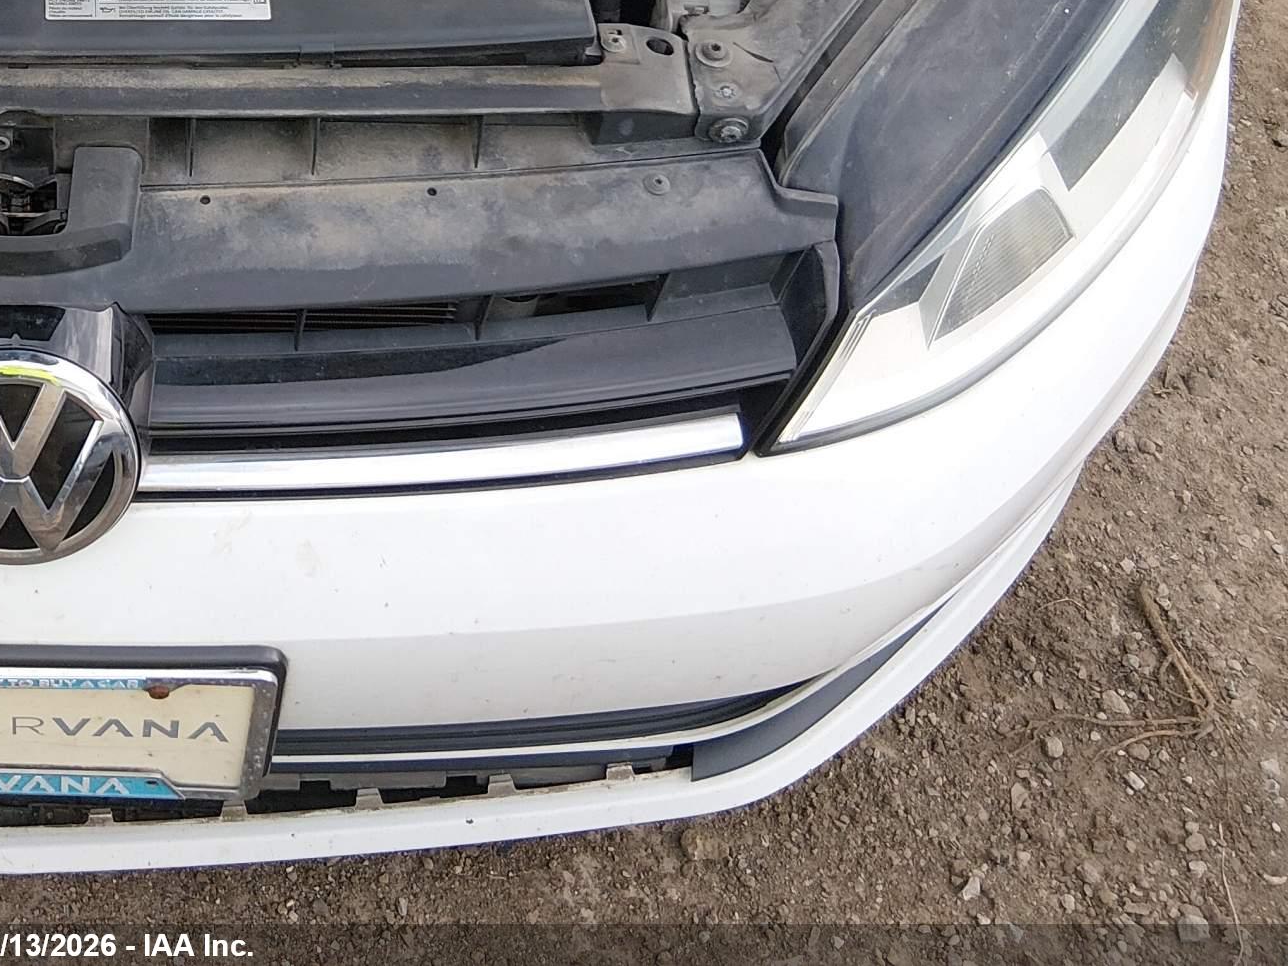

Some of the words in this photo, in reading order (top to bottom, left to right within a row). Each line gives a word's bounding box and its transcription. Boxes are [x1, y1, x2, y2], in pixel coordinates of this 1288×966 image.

[8, 678, 34, 688] TO
[39, 678, 77, 689] BUY
[80, 679, 95, 689] A
[97, 679, 139, 689] CAR
